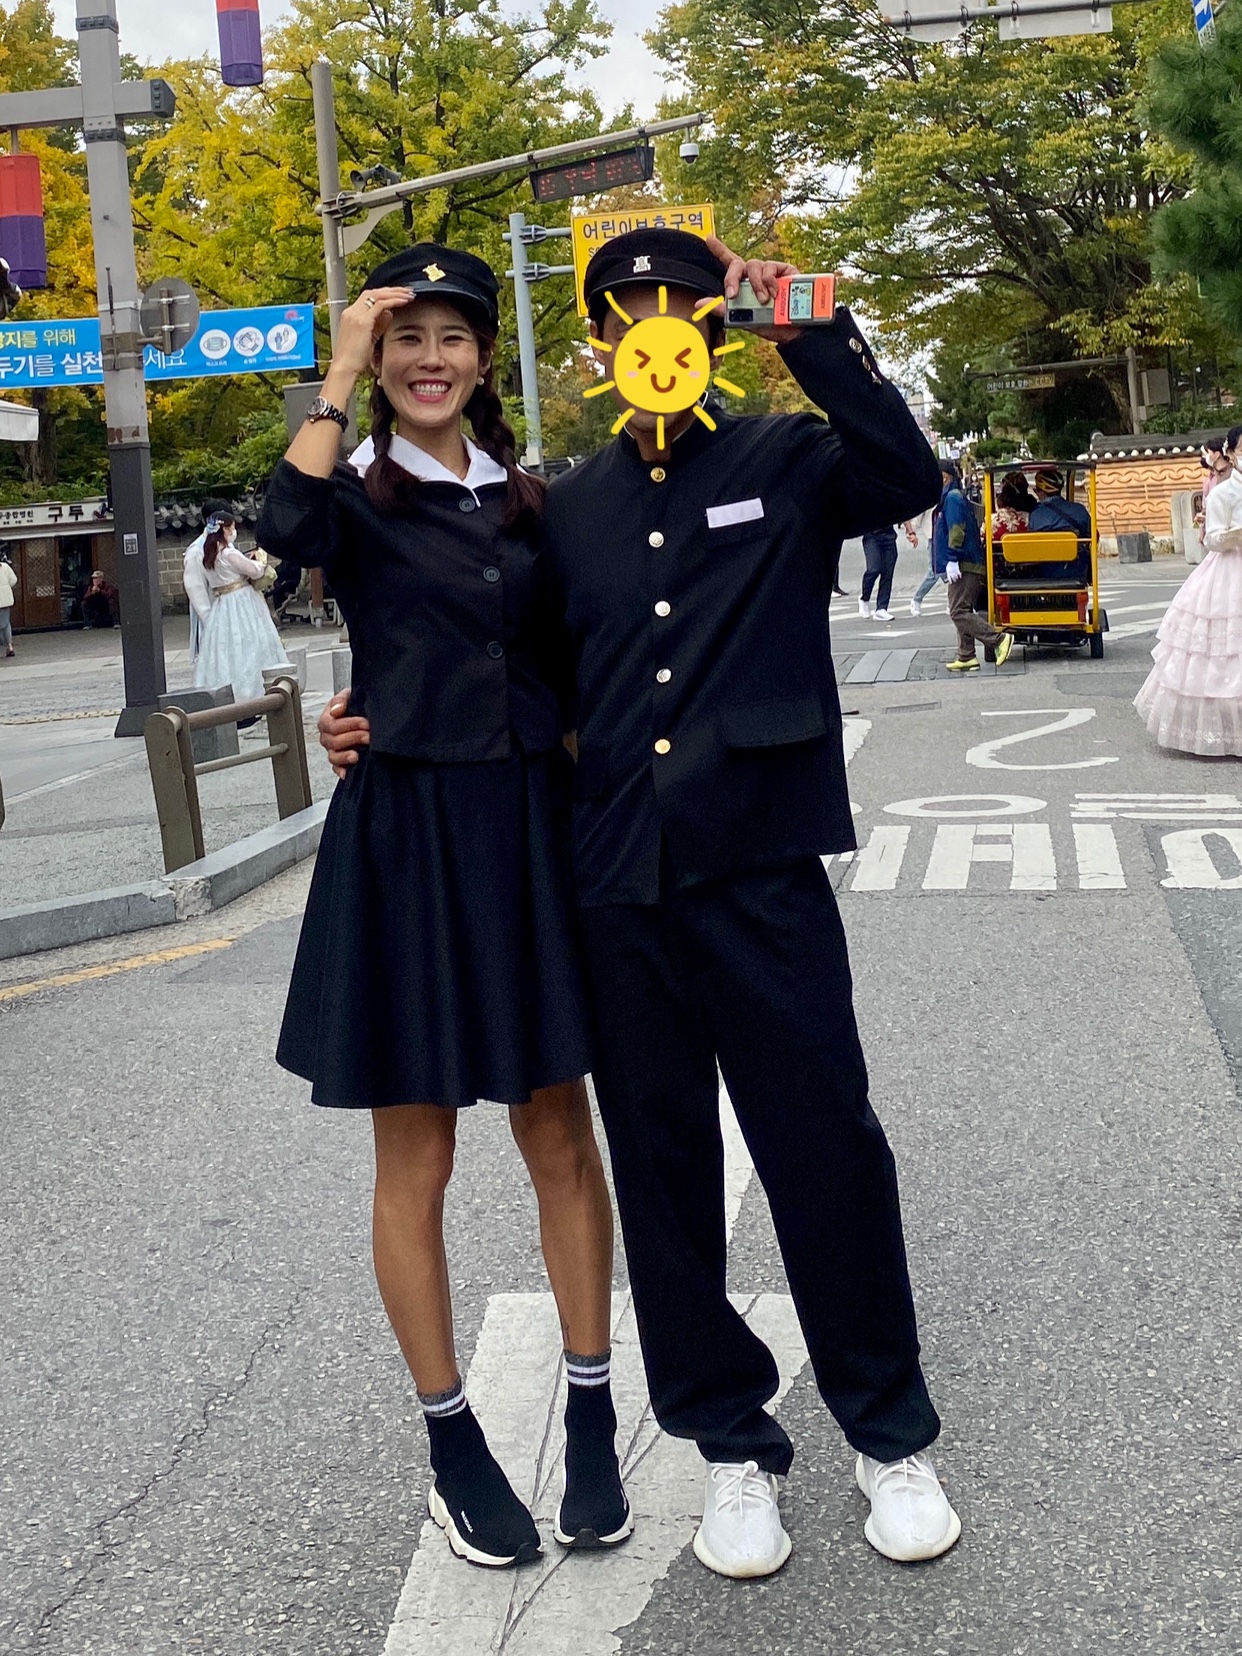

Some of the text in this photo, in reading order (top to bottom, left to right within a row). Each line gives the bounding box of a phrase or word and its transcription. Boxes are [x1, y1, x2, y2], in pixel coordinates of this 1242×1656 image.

[43, 328, 77, 347] 위해
[143, 348, 188, 370] 세요
[48, 505, 84, 522] 구두
